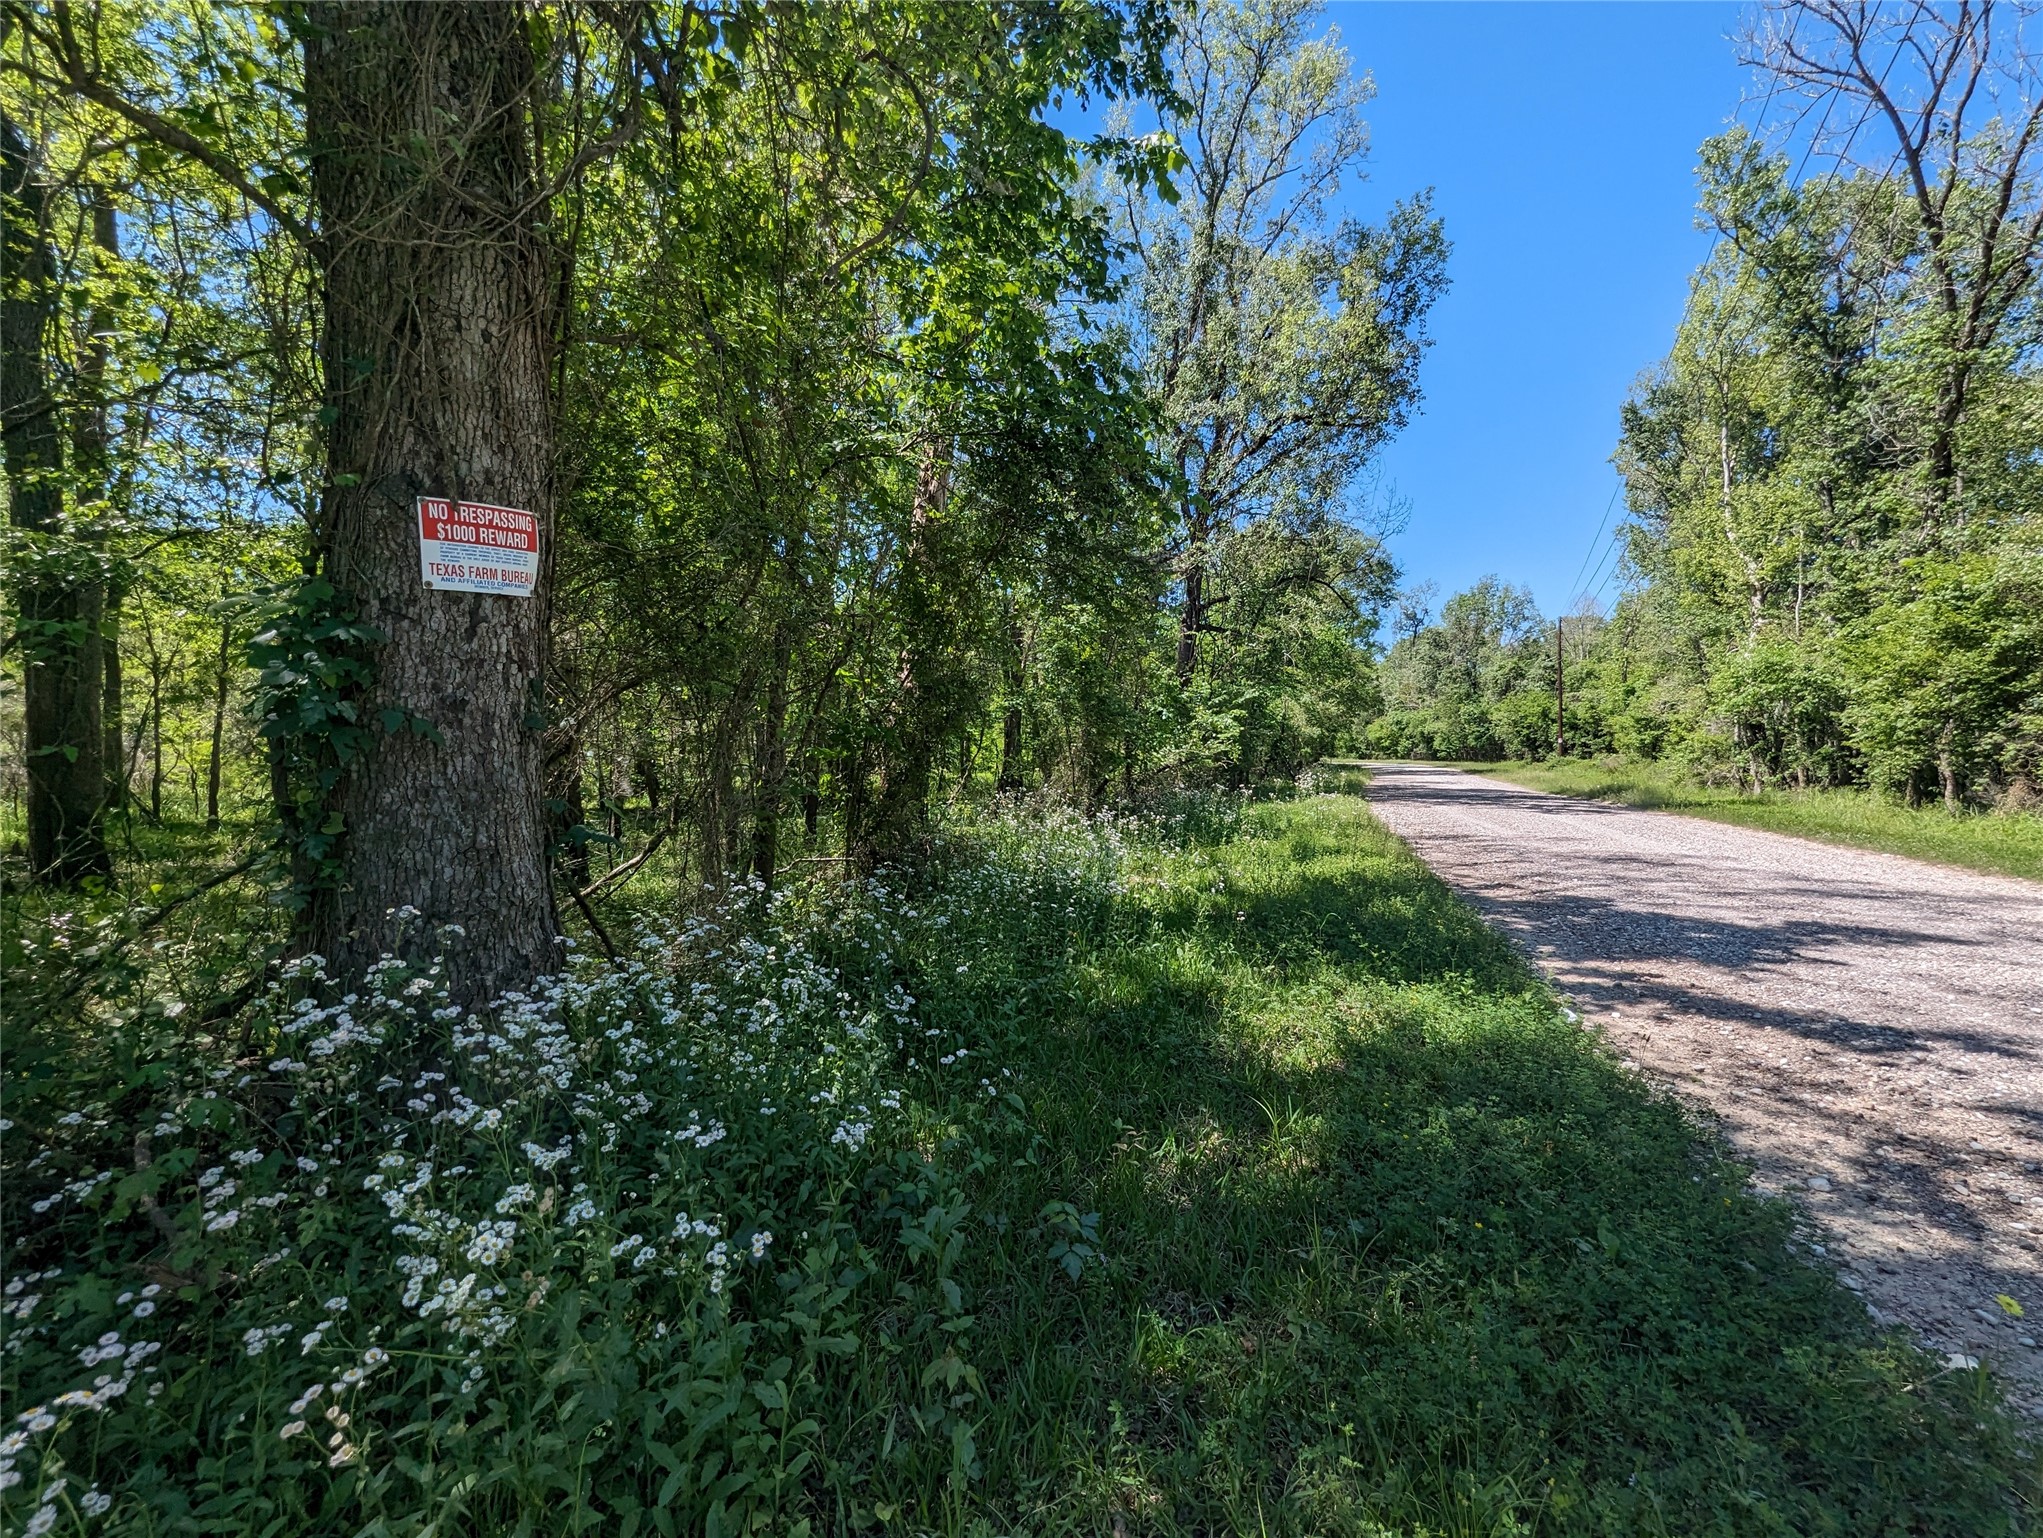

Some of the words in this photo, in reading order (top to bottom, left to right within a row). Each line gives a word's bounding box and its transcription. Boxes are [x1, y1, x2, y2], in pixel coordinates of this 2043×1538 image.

[428, 502, 448, 520] NO
[437, 522, 476, 542] $1000
[480, 527, 528, 549] REWARD
[429, 562, 465, 578] TEXAS
[468, 566, 498, 581] FARM
[501, 569, 534, 585] BUREAU
[458, 578, 496, 587] AFFILIATED
[497, 581, 528, 590] COMPANIES
